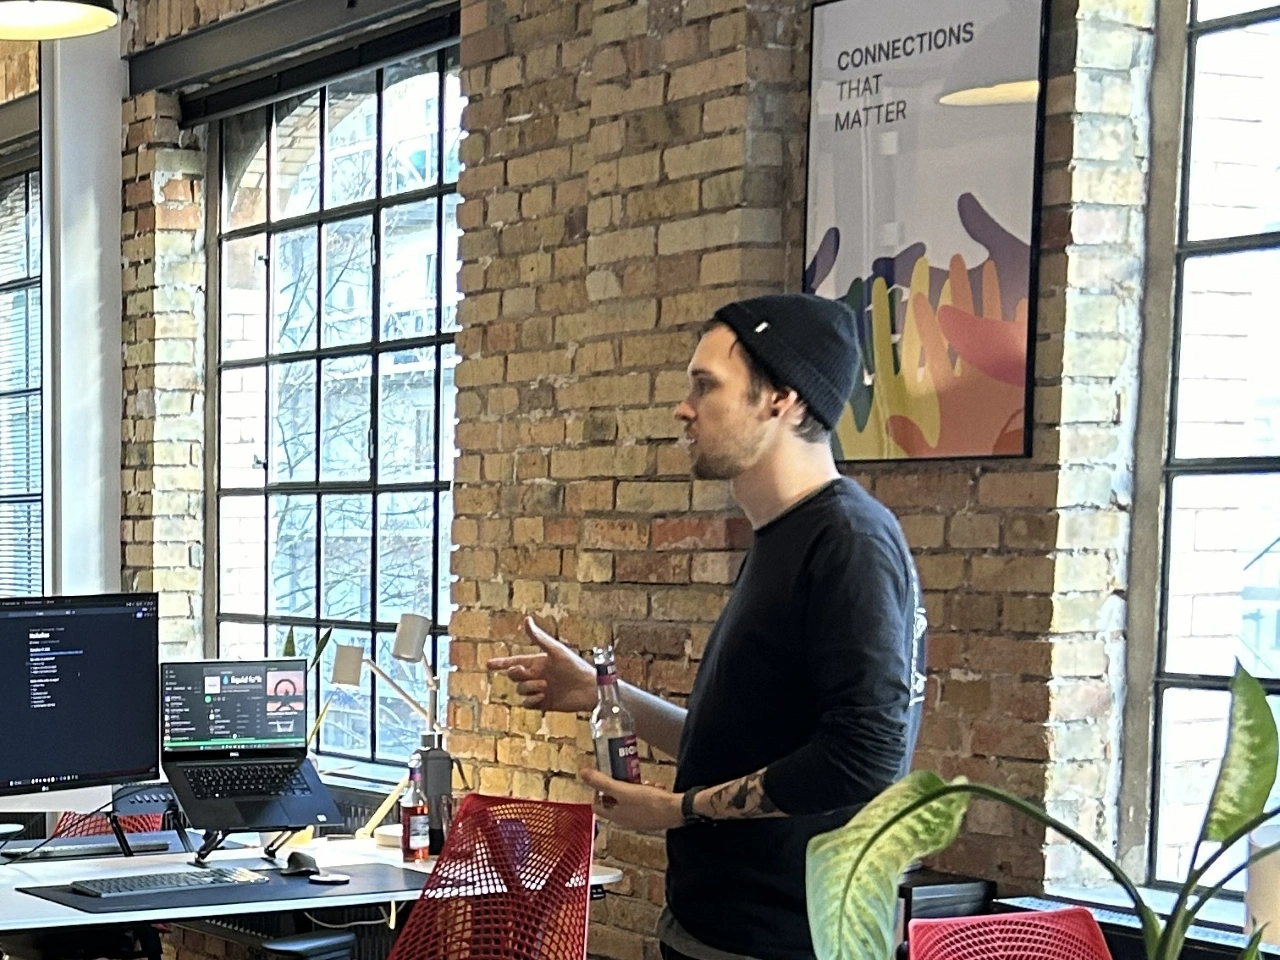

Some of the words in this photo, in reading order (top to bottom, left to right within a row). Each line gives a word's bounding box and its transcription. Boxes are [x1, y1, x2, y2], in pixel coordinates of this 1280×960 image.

[837, 21, 974, 71] CONNECTIONS
[837, 73, 883, 102] THAT
[834, 99, 907, 133] MATTER
